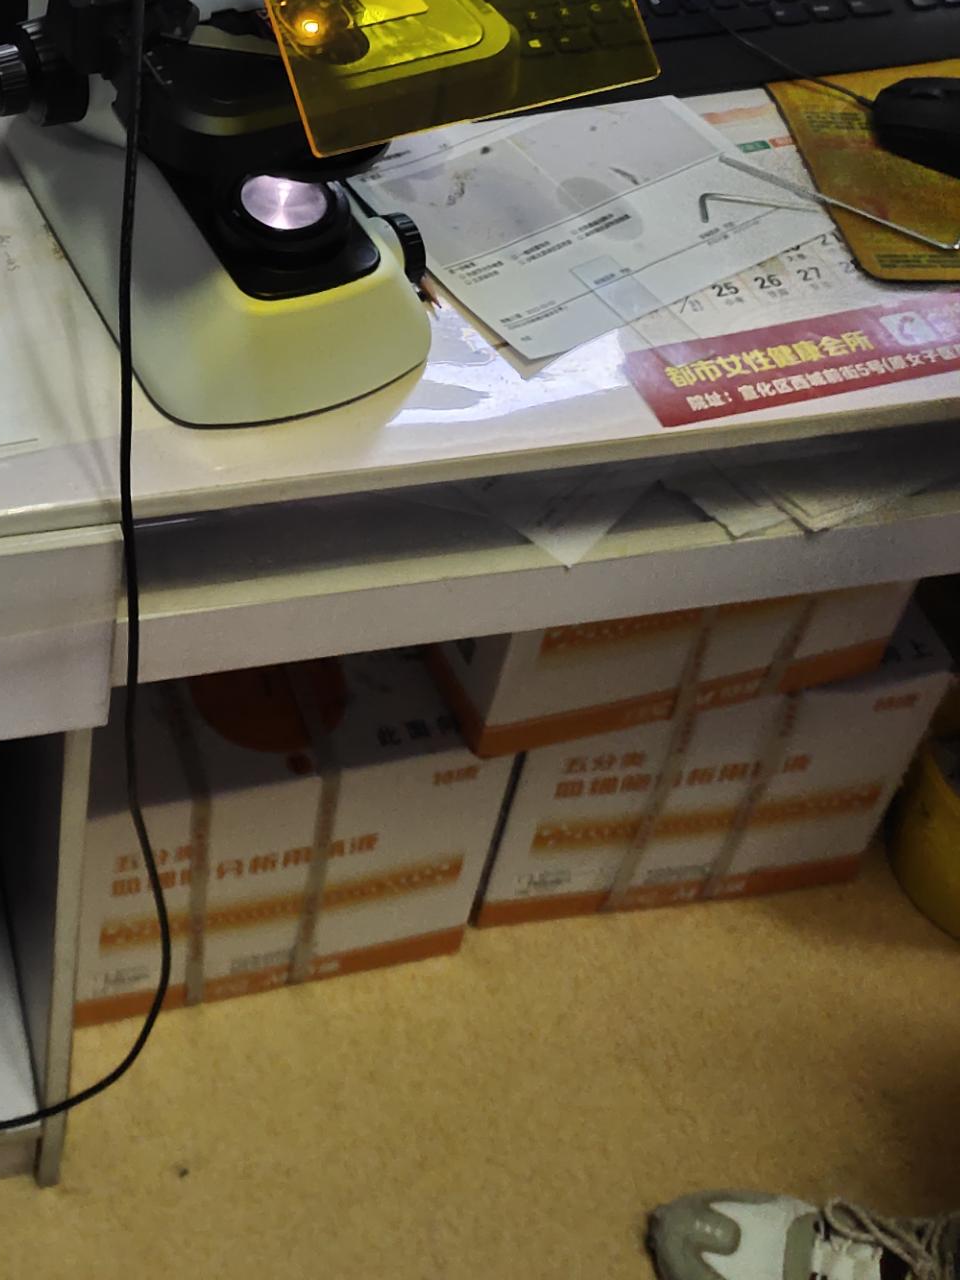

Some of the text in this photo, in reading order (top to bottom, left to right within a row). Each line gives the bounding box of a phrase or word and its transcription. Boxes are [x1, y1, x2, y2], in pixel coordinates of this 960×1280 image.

[712, 282, 739, 298] 25
[754, 274, 782, 289] 26
[797, 267, 821, 281] 27
[664, 330, 876, 388] 都市女性健康会所
